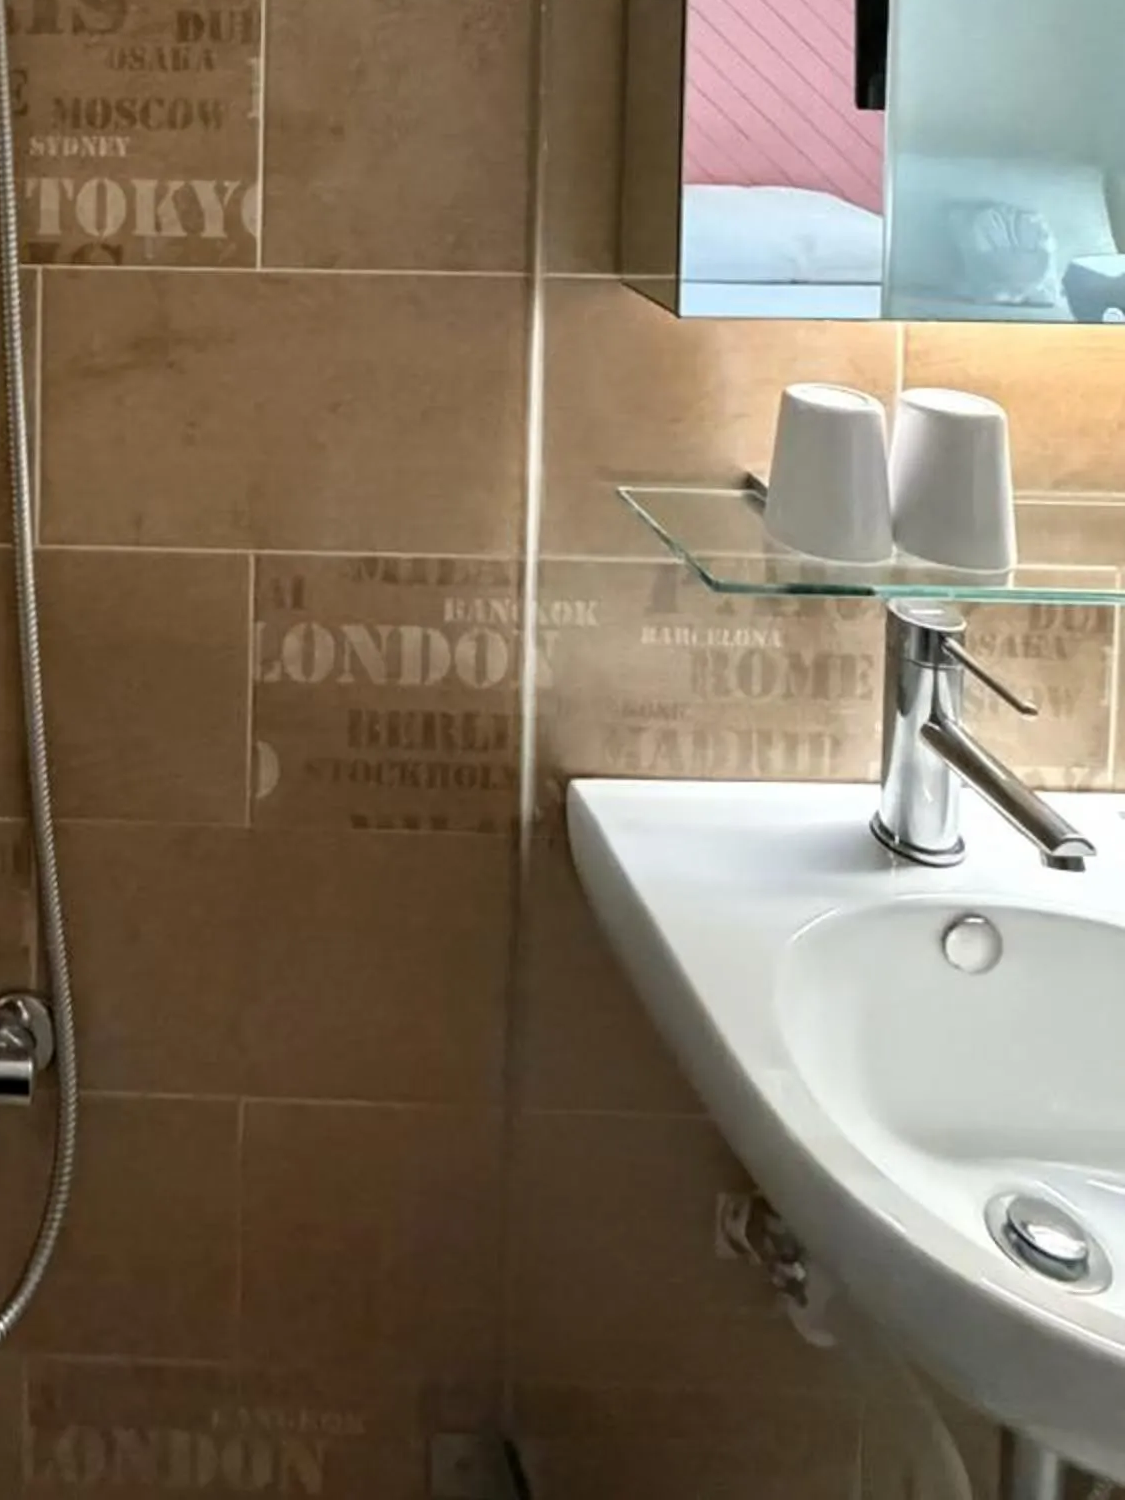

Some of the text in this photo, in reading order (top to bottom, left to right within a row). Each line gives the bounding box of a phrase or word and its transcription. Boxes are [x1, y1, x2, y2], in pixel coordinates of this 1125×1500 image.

[52, 97, 226, 131] MOSCOW
[29, 134, 131, 157] SYDNEY
[641, 625, 784, 648] BARCELONA
